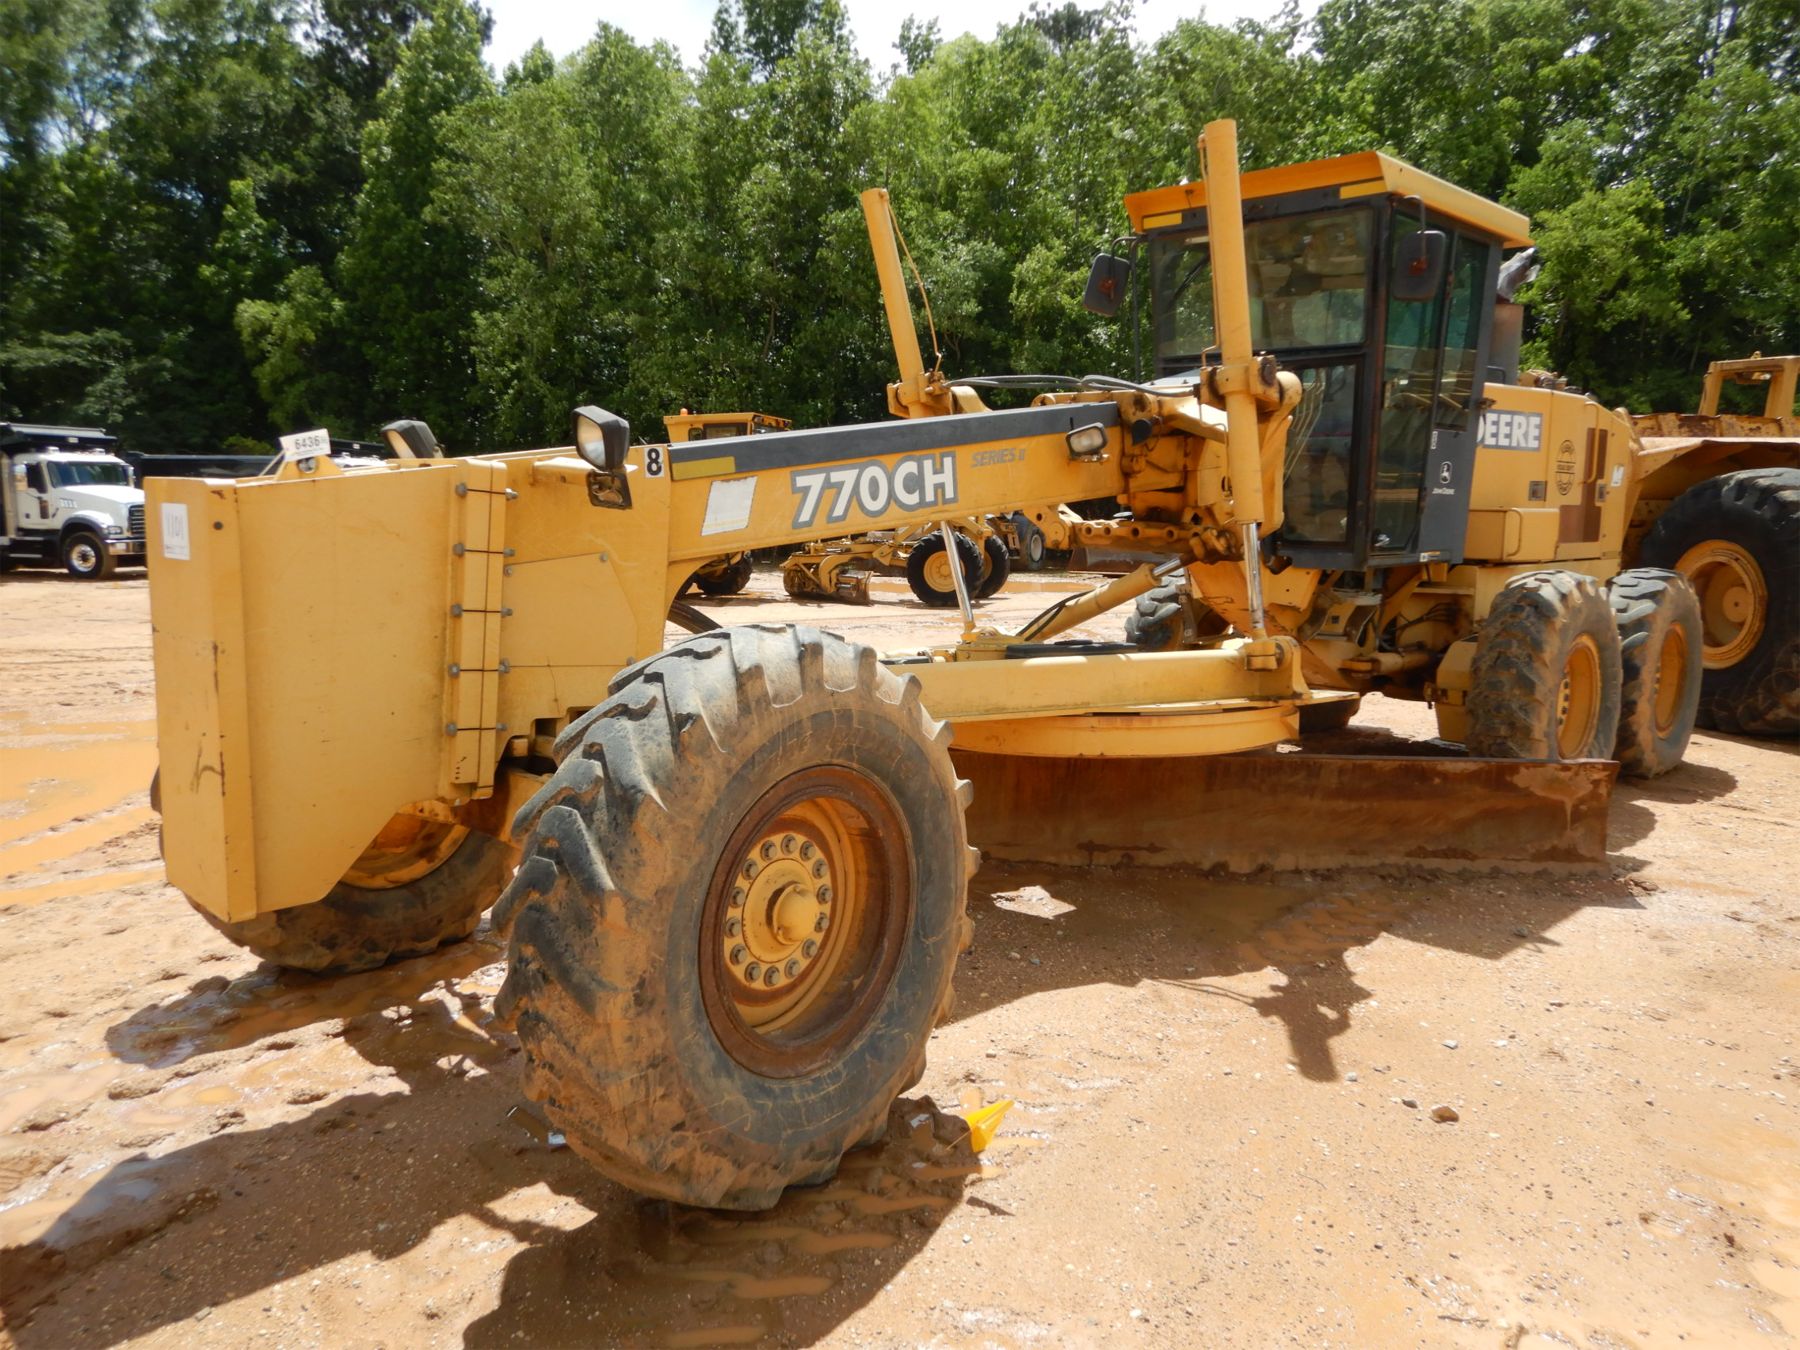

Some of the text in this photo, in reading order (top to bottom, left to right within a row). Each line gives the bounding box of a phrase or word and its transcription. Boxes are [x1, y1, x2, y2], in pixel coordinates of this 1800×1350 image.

[294, 435, 320, 450] 6436
[647, 447, 662, 476] 8
[795, 456, 955, 523] 770CH
[971, 448, 1016, 467] SERIES
